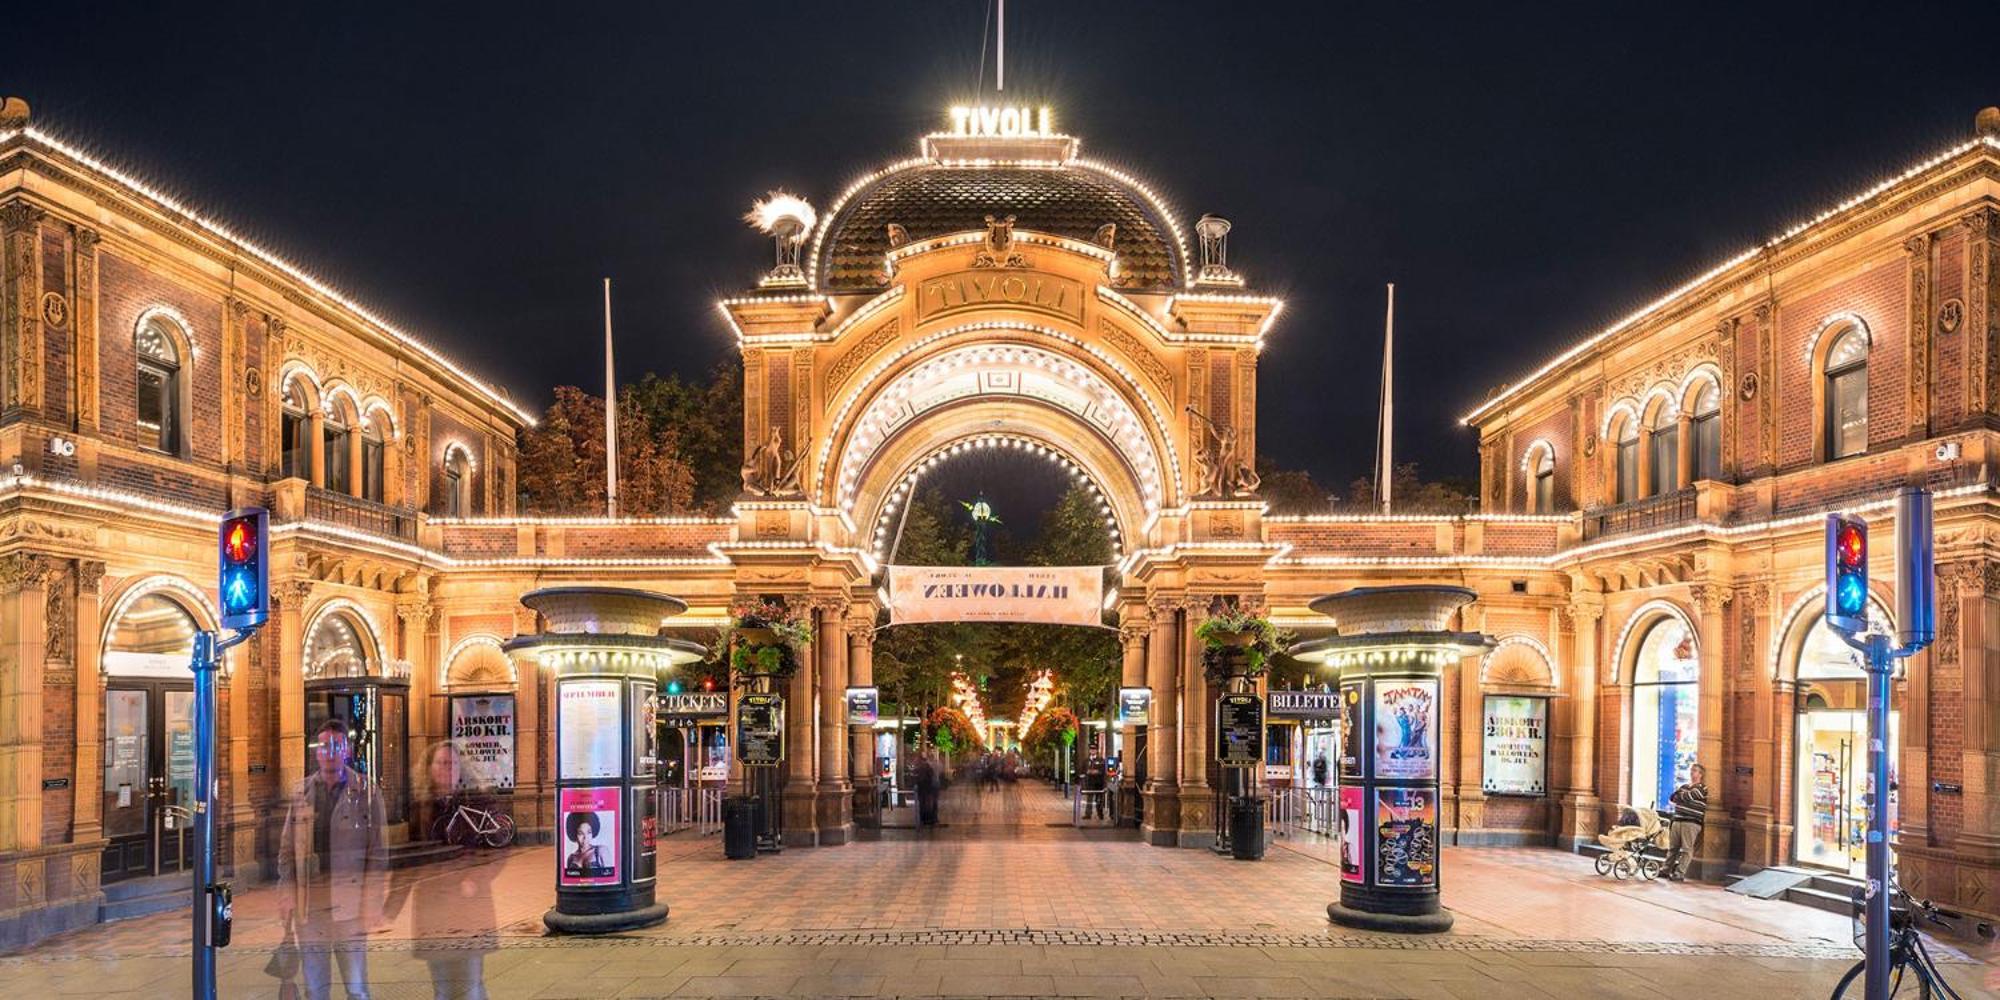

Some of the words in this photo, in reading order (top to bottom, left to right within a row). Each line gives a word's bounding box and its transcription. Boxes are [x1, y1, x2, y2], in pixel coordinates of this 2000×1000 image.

[951, 107, 1050, 136] TIVOLI
[930, 276, 1066, 308] TIVOLI
[667, 693, 725, 708] TICKETS
[456, 725, 481, 737] 280
[485, 725, 511, 736] KR.
[1516, 727, 1542, 739] KR.
